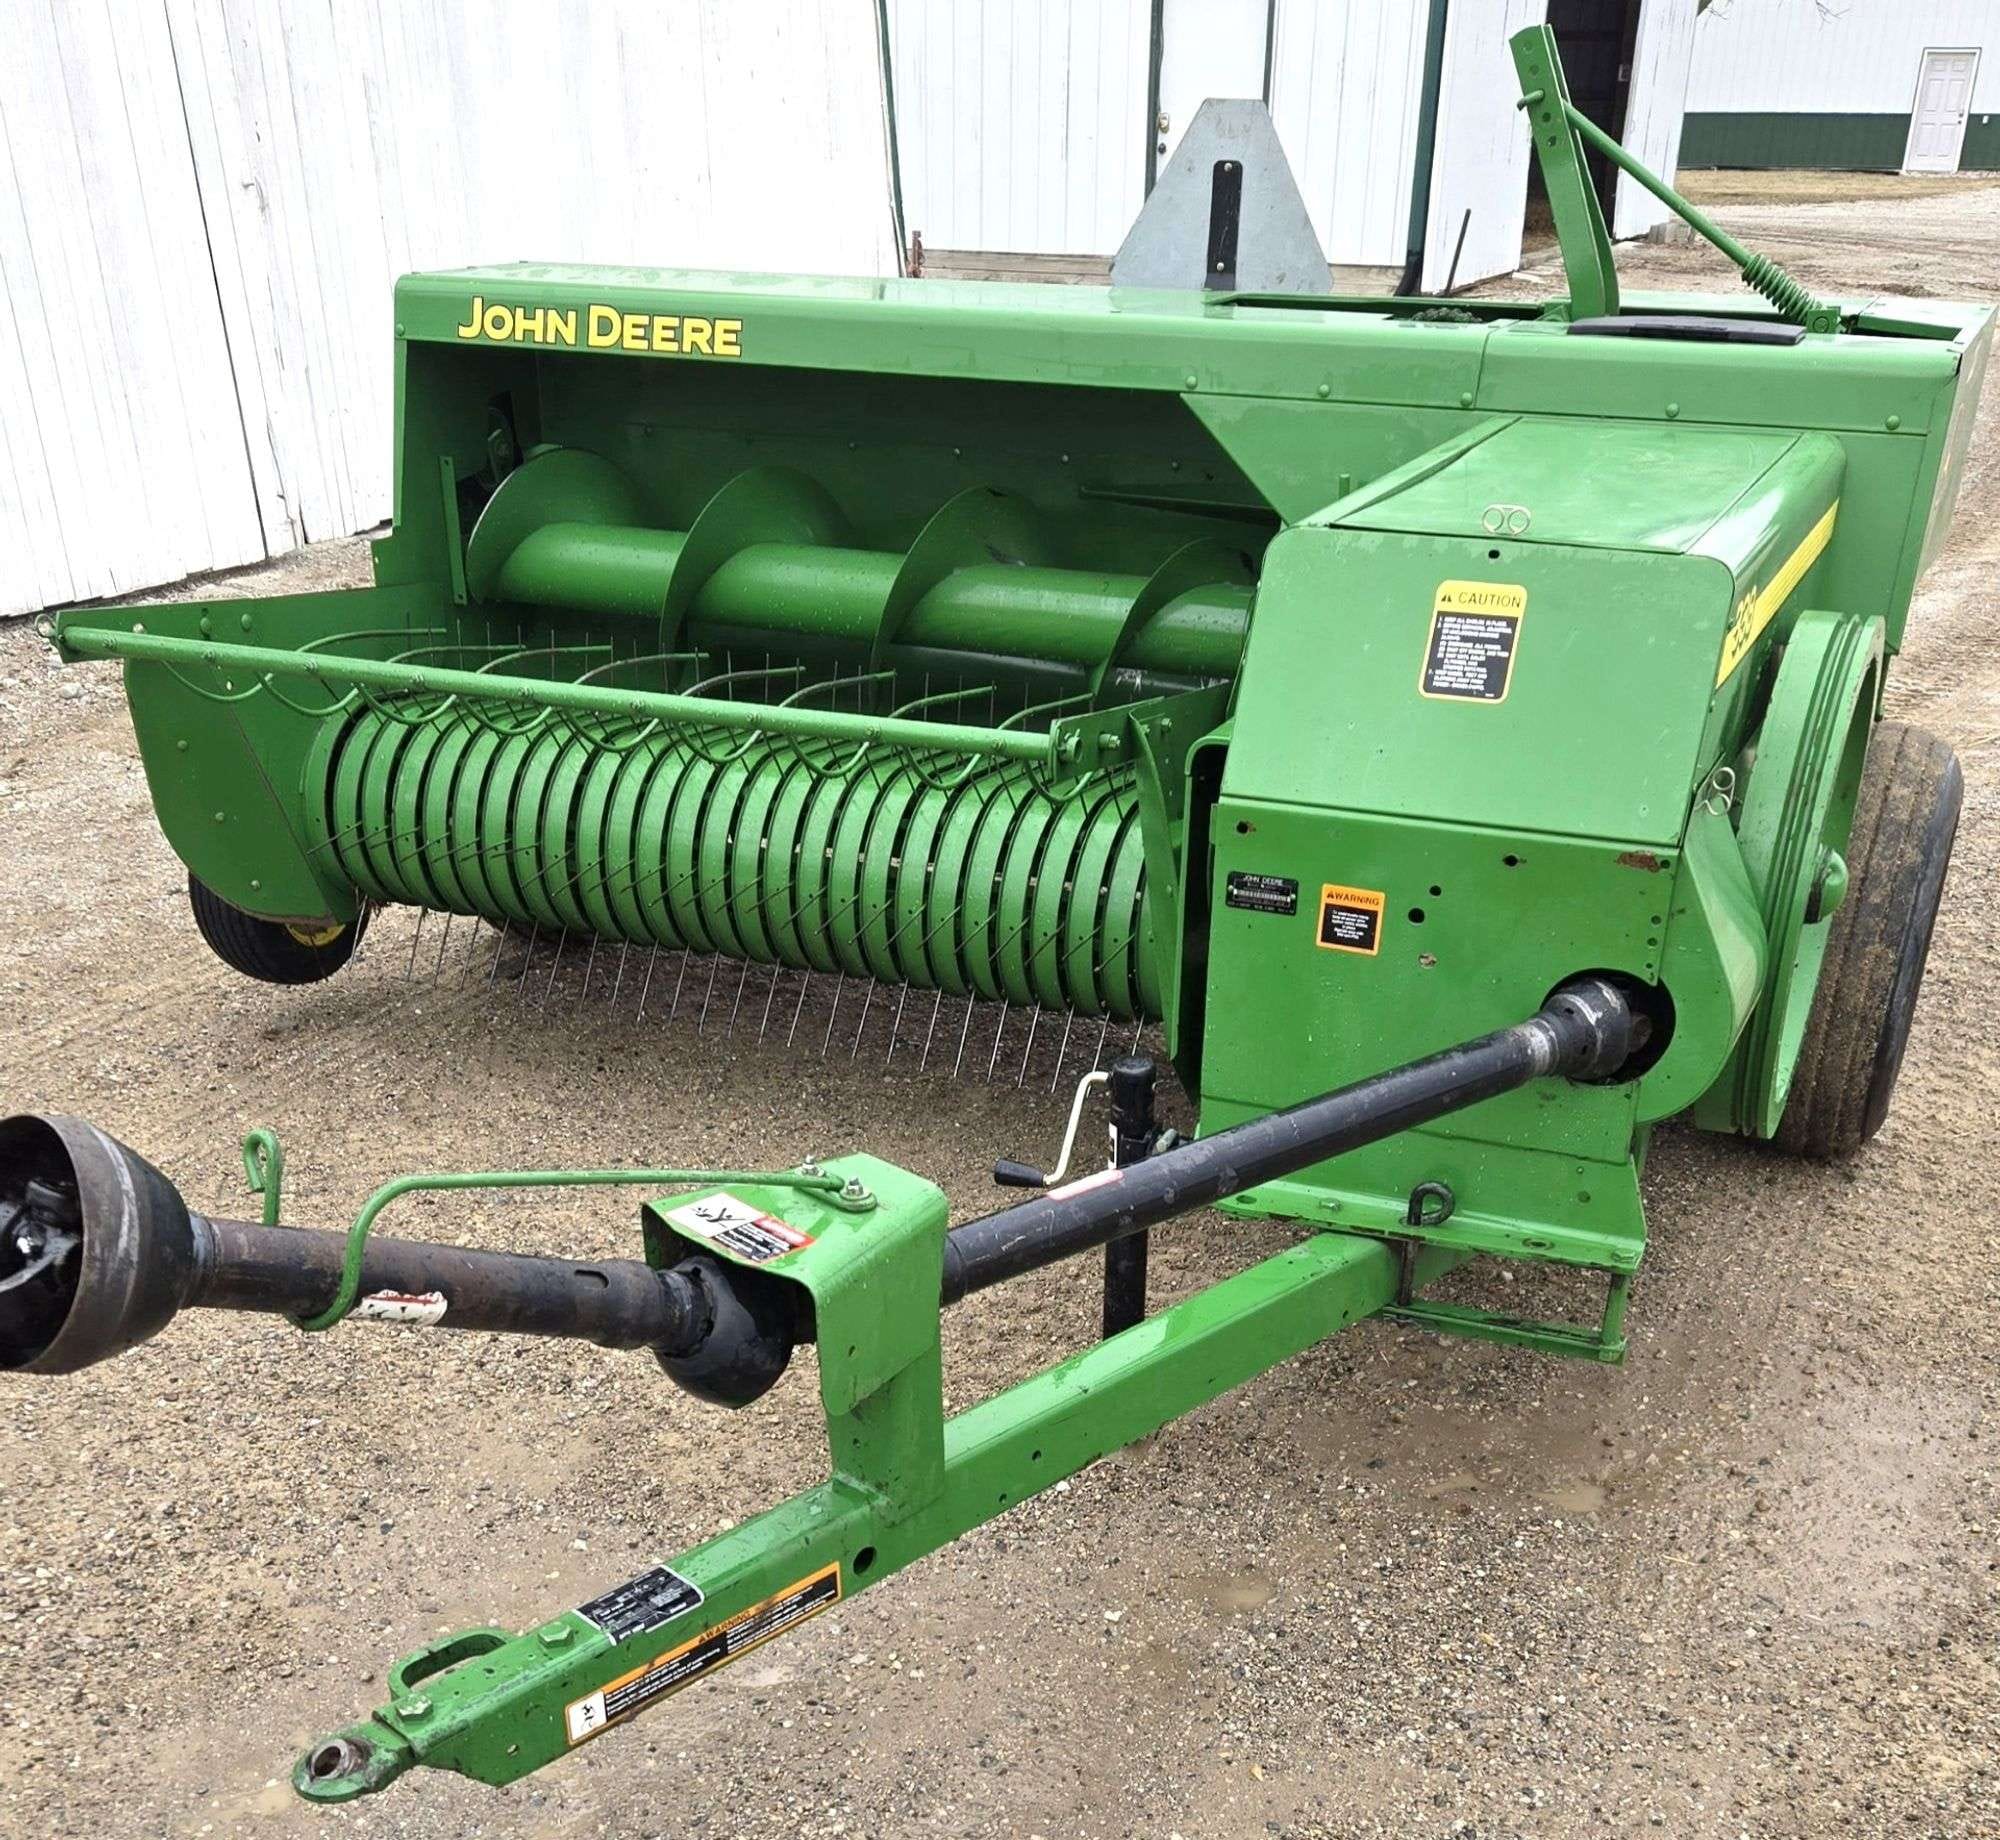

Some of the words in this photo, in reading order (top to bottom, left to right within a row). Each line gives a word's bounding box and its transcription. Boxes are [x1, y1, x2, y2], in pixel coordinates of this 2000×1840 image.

[457, 295, 577, 347] JOHN
[587, 303, 743, 357] DEERE
[1457, 591, 1522, 608] CAUTION
[1262, 876, 1283, 886] DEERE
[1335, 892, 1380, 906] WARNING
[705, 1610, 752, 1636] WARNING
